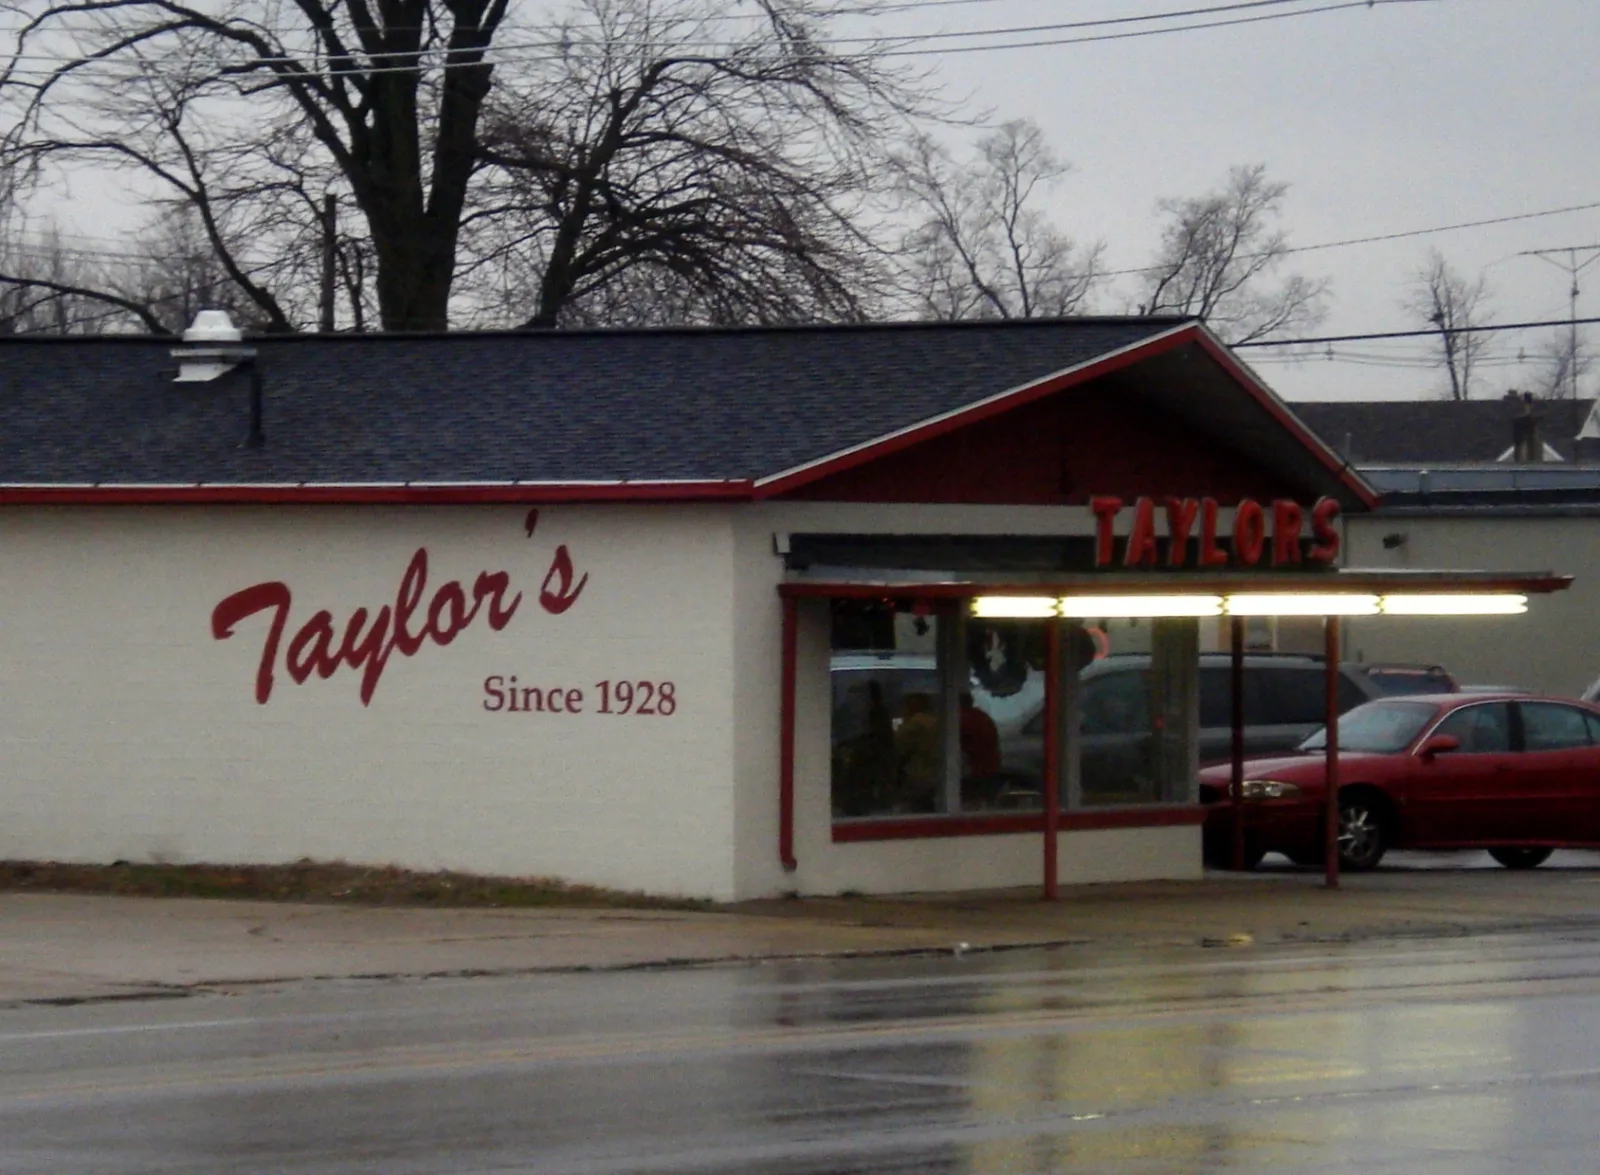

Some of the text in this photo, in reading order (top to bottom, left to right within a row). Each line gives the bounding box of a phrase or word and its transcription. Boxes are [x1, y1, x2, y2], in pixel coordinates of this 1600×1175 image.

[1091, 496, 1340, 566] TAYLORS
[211, 508, 588, 707] Taylor's
[483, 676, 676, 716] Since 1928
